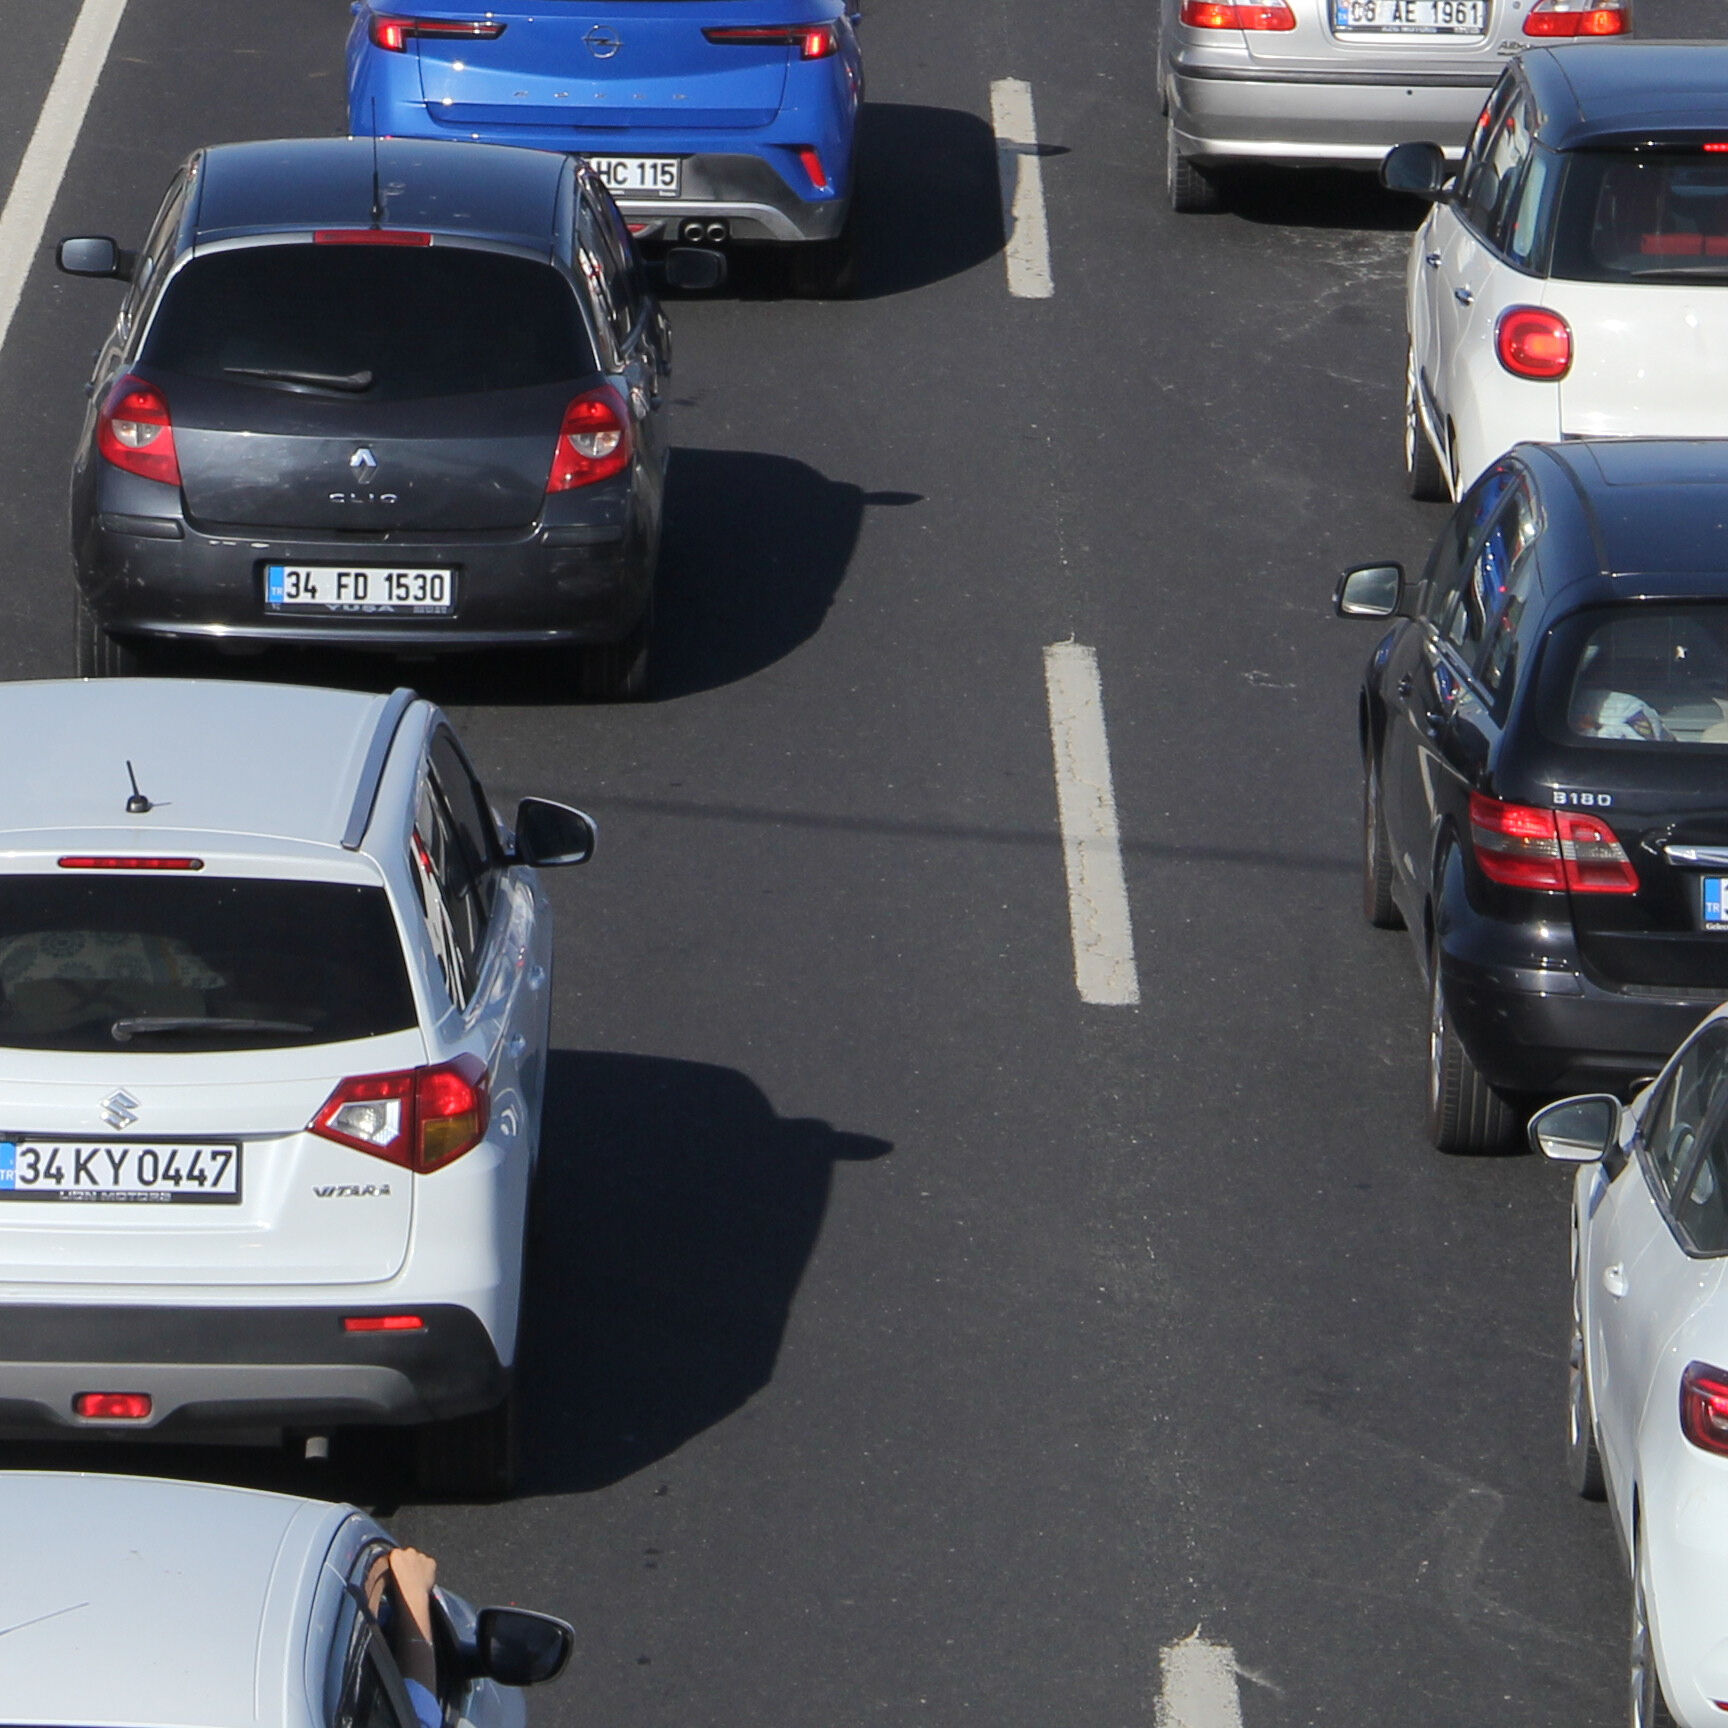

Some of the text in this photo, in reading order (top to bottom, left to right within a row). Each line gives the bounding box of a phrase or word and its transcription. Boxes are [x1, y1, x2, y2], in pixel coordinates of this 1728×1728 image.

[1392, 0, 1417, 22] AE
[1431, 0, 1478, 25] 1961
[593, 160, 675, 186] HC 115
[272, 571, 445, 602] TR 34 FD 1530
[1706, 902, 1720, 913] TR
[0, 1168, 14, 1181] TR
[100, 1192, 172, 1203] MOTORS
[312, 1184, 390, 1198] VITARA
